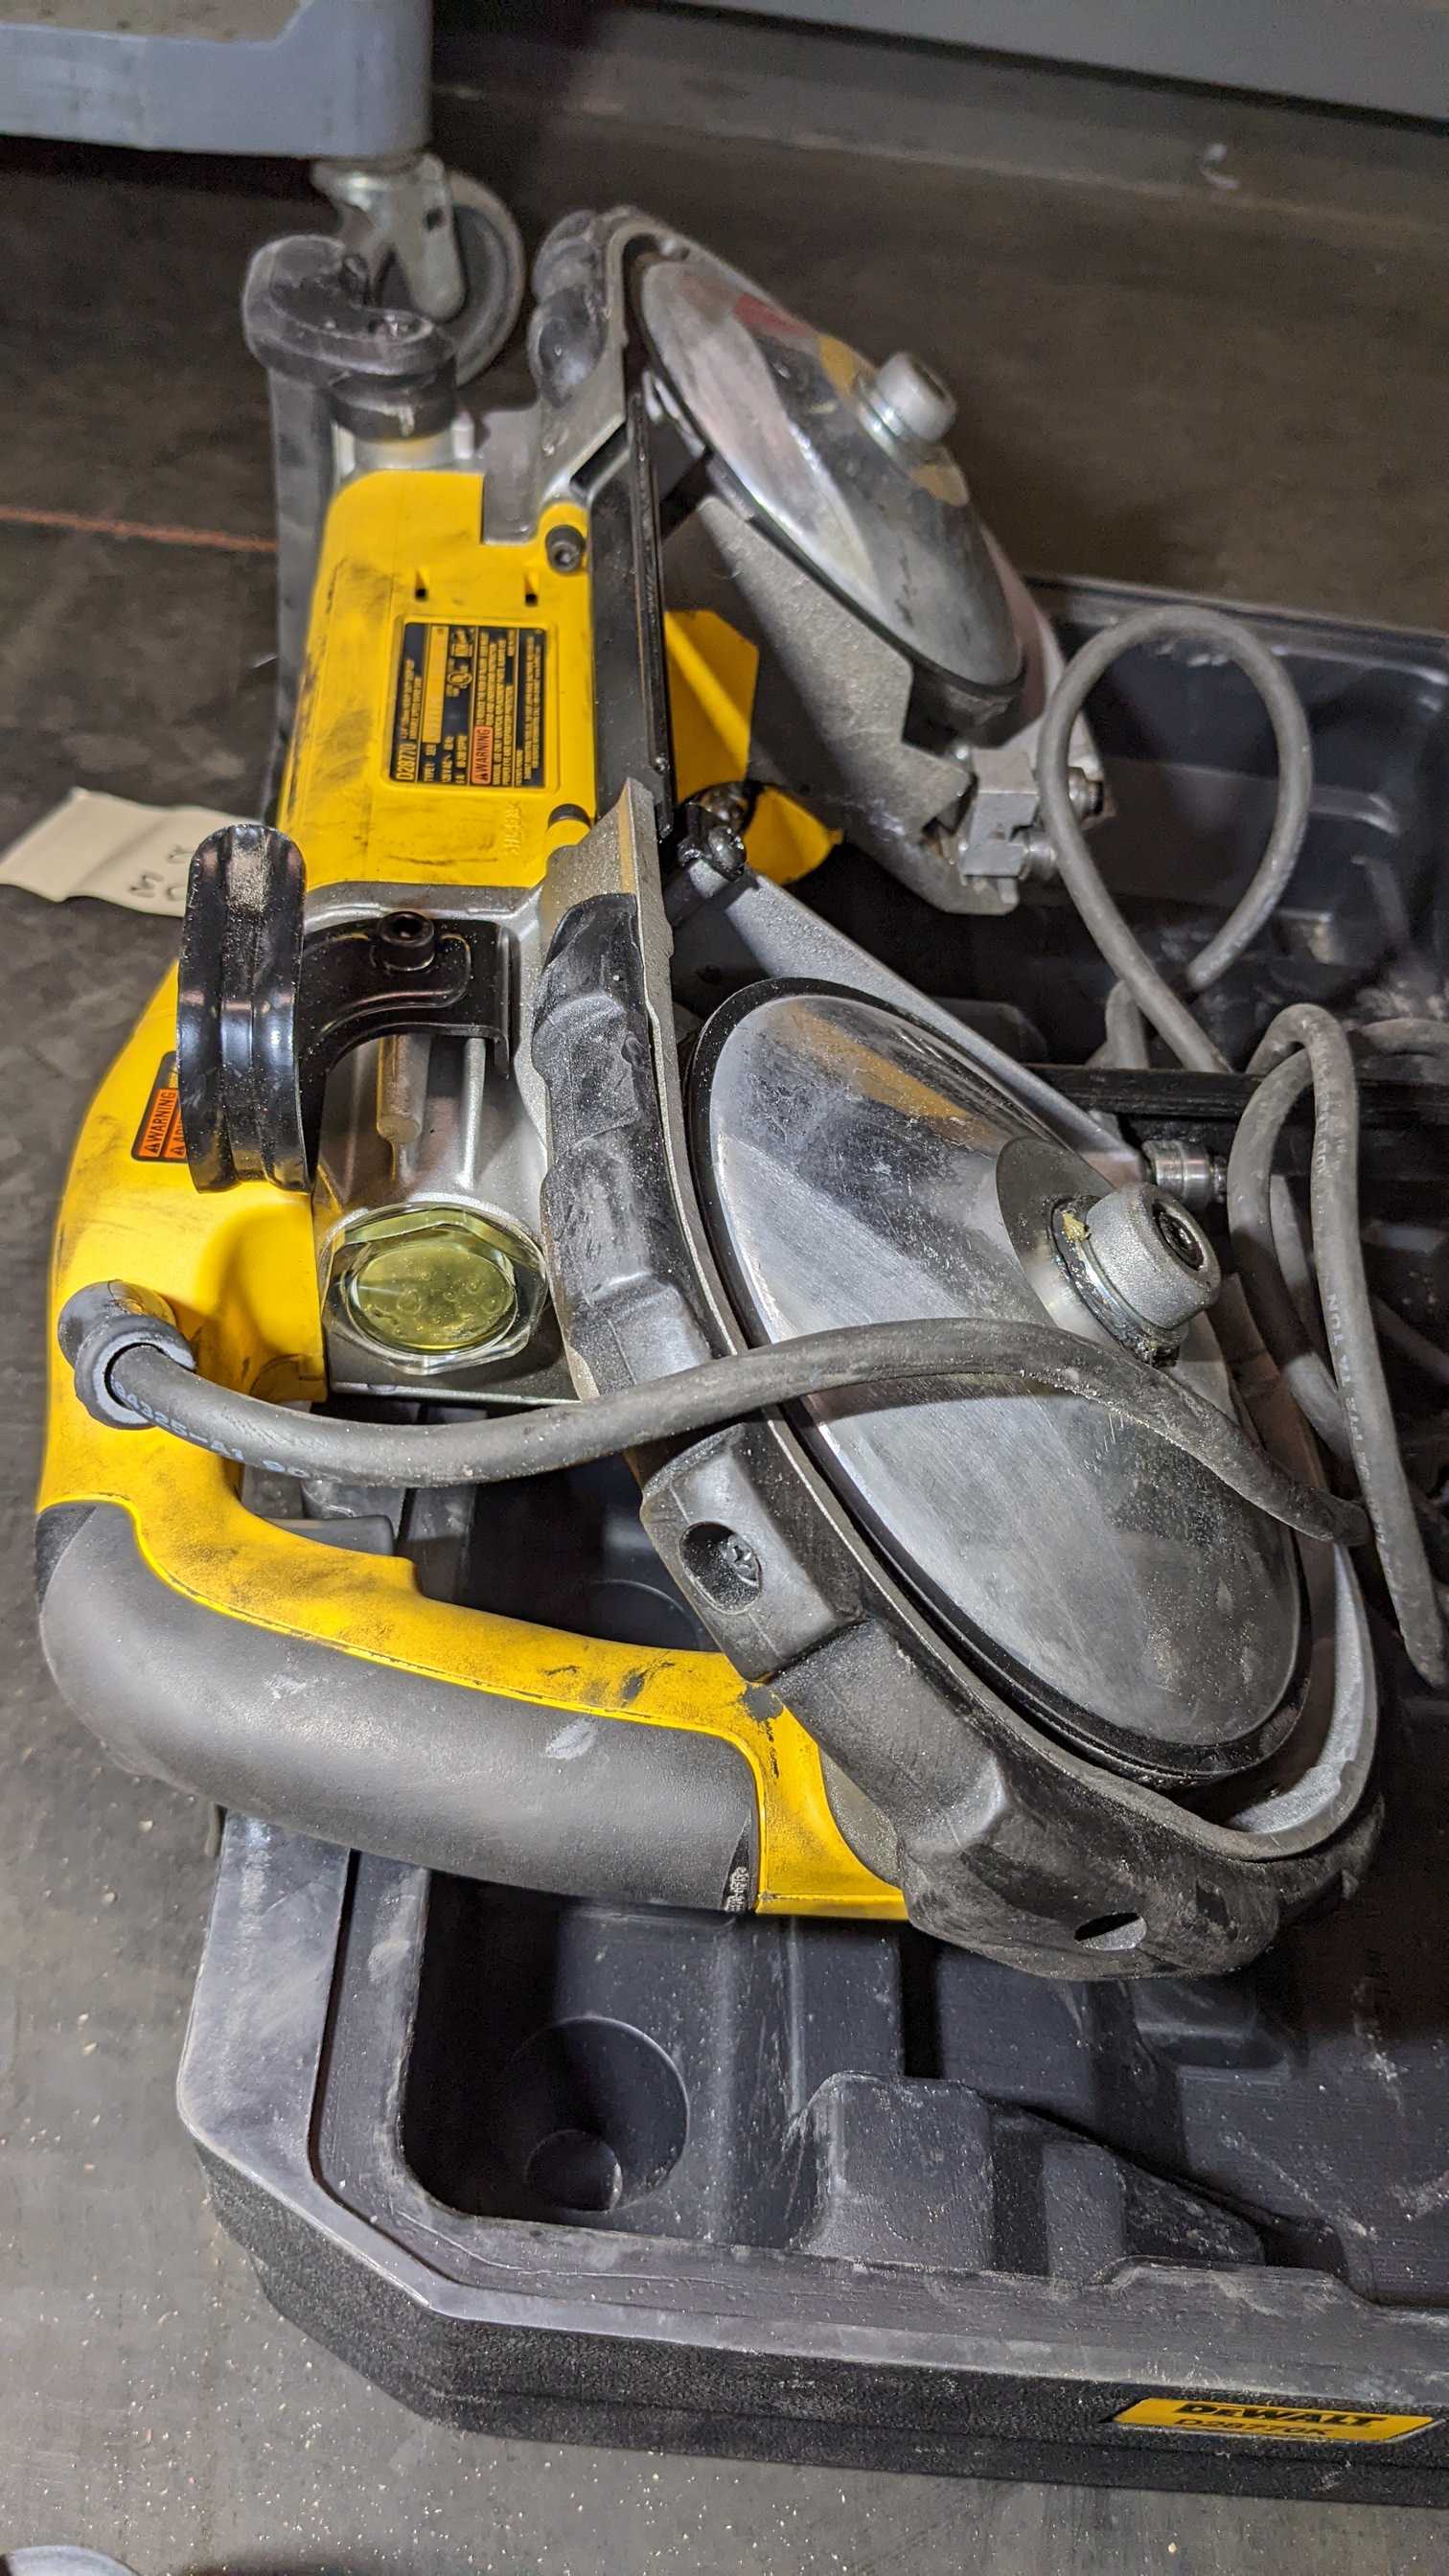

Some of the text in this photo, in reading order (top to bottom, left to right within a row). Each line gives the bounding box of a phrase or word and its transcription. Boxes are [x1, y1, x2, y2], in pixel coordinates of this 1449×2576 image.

[396, 743, 417, 781] D28770
[473, 728, 491, 772] WARNING
[150, 1092, 175, 1139] WARNING
